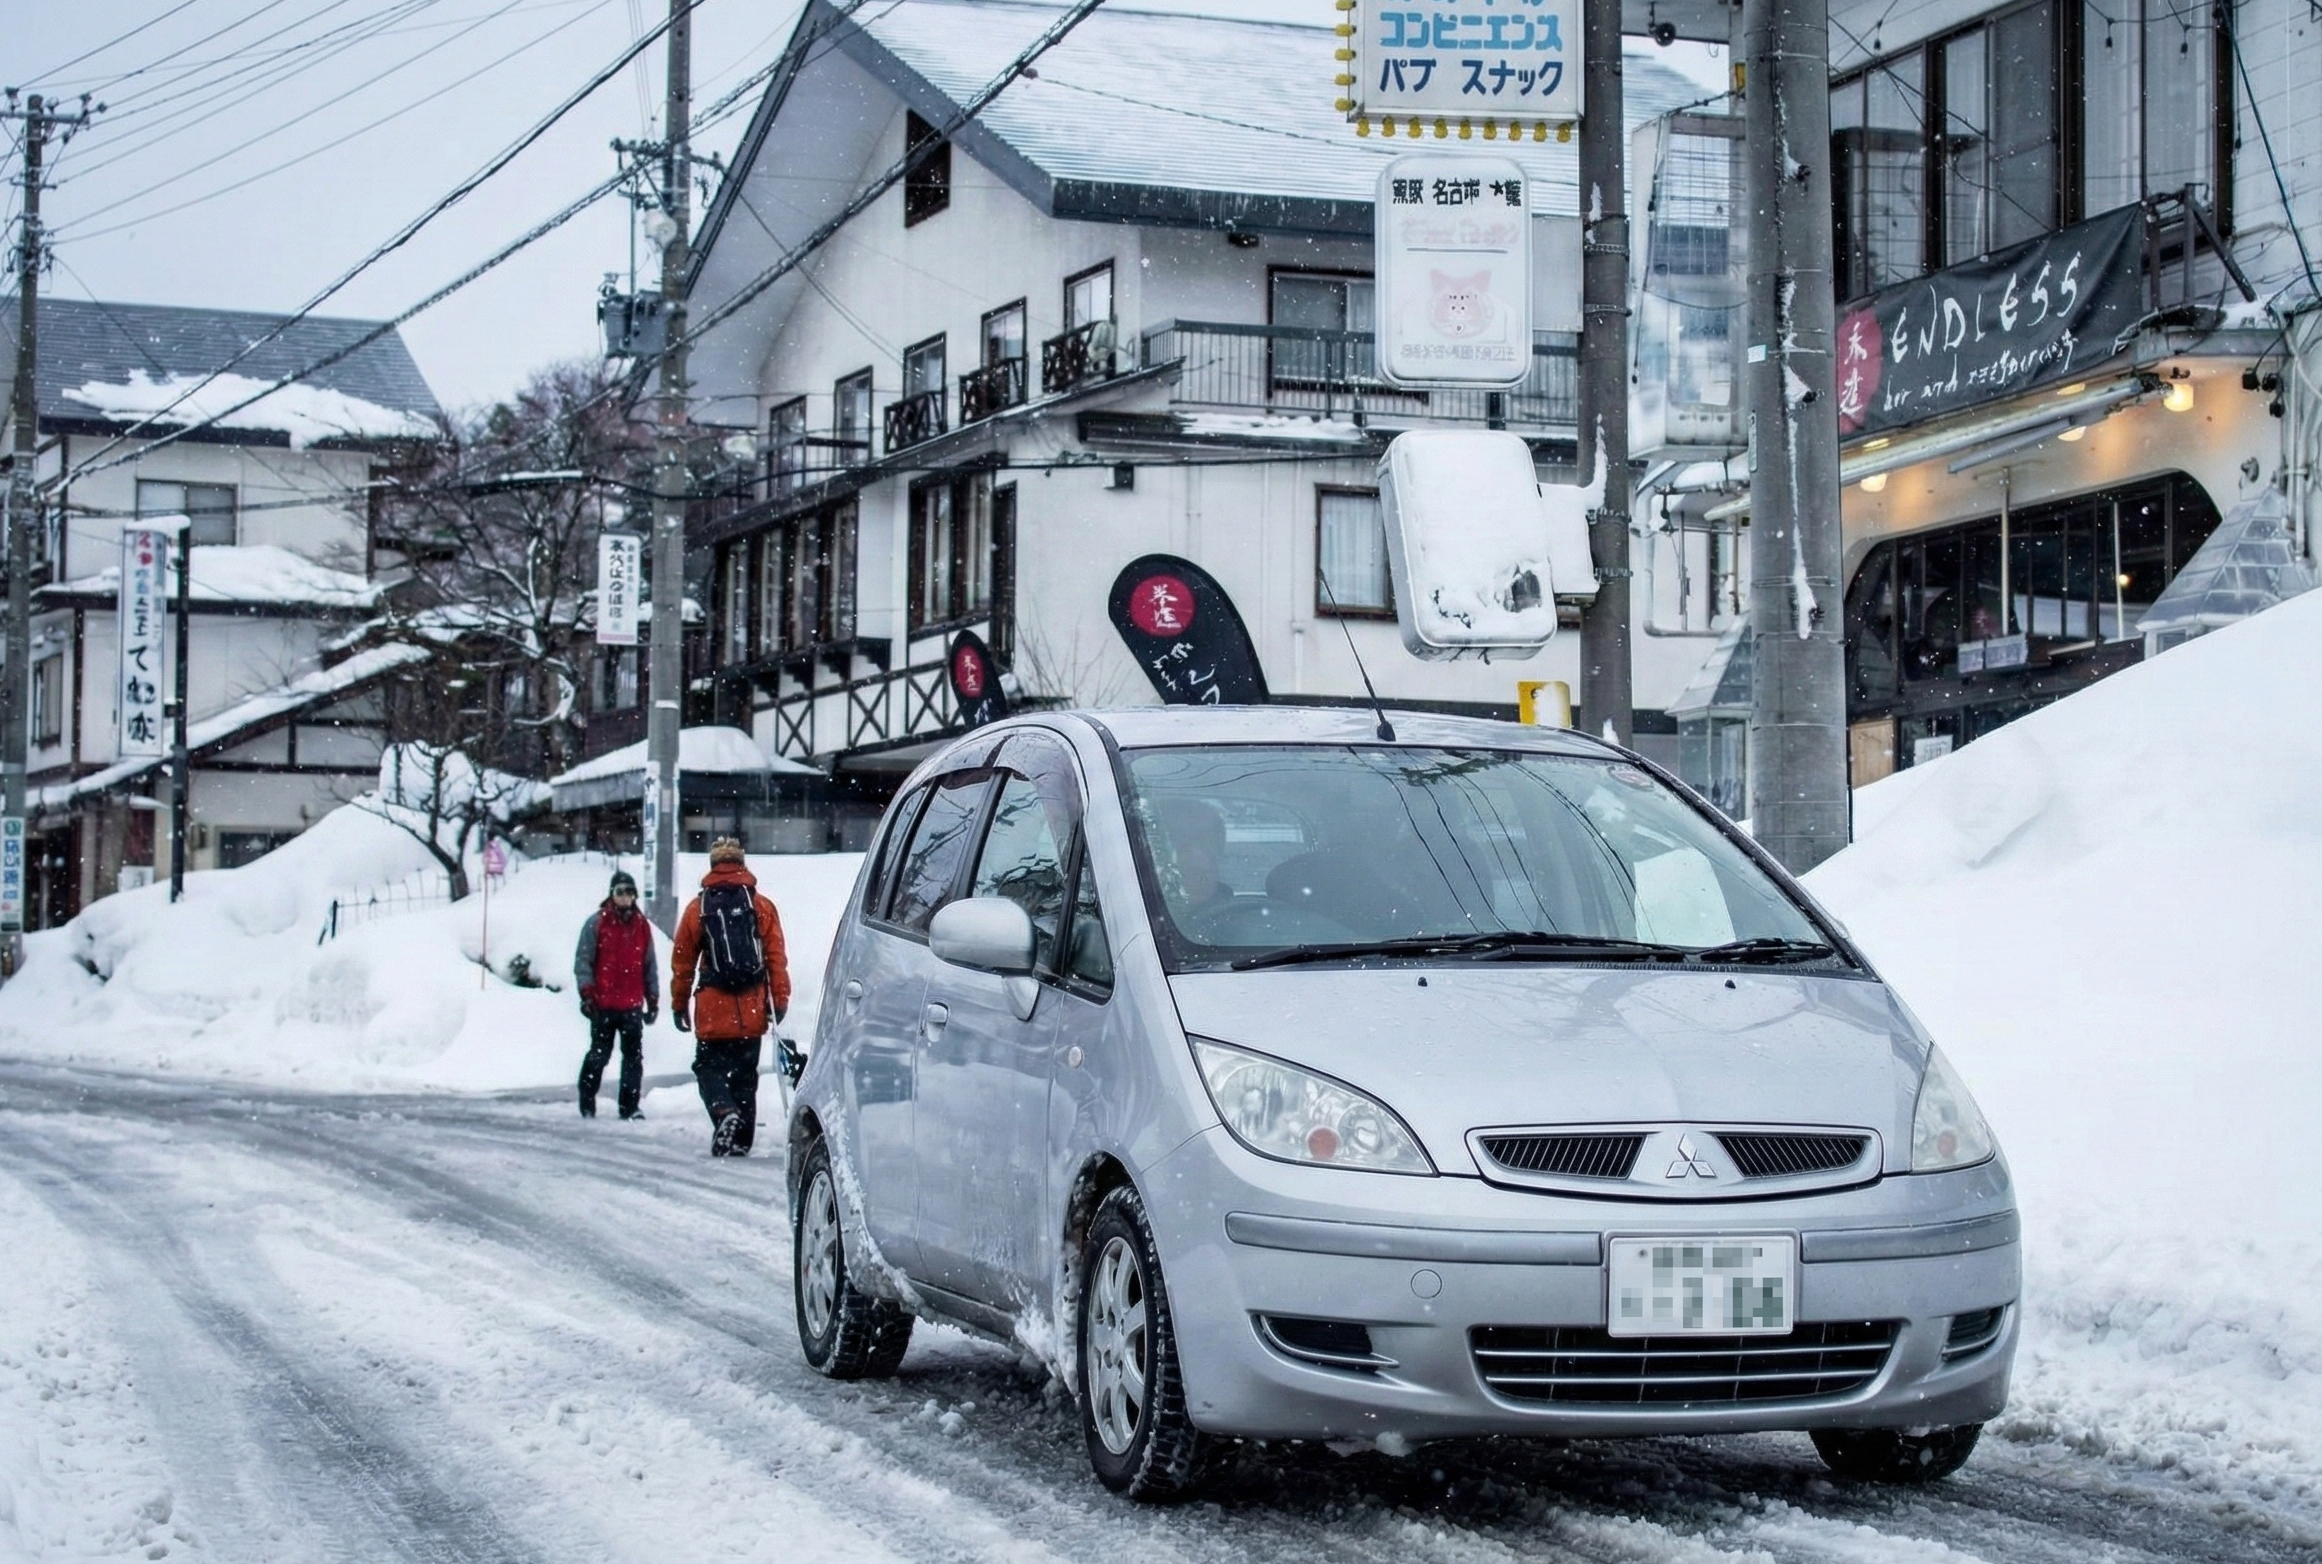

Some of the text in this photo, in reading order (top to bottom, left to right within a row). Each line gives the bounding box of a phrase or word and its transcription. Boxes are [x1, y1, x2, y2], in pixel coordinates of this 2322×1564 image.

[1380, 12, 1562, 52] コンビニエンス
[1462, 59, 1564, 96] スナック
[1890, 250, 2082, 364] ENDLESS
